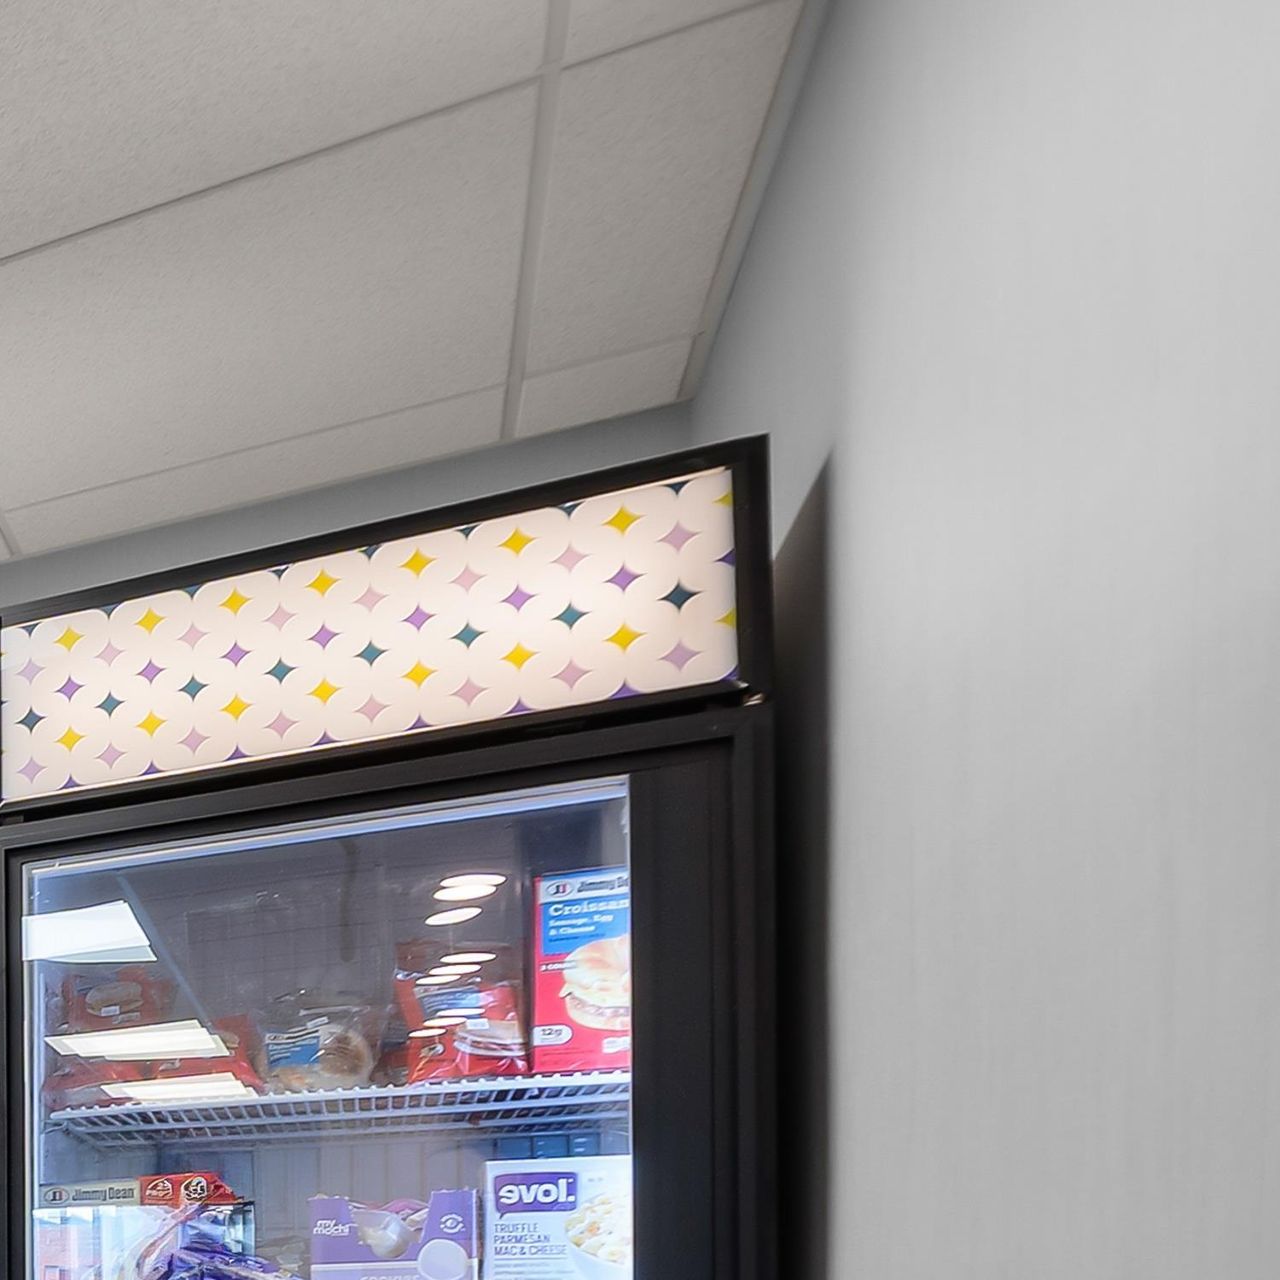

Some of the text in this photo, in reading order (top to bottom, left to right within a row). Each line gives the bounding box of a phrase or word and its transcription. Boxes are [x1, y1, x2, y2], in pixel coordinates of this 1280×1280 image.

[71, 1187, 107, 1202] Jimmy
[109, 1186, 134, 1200] Dean
[313, 1224, 350, 1236] mochi
[316, 1219, 337, 1231] my
[494, 1223, 539, 1233] TRUFFLE
[494, 1235, 551, 1244] PARMESAN
[494, 1245, 567, 1255] MAC & CHEESE
